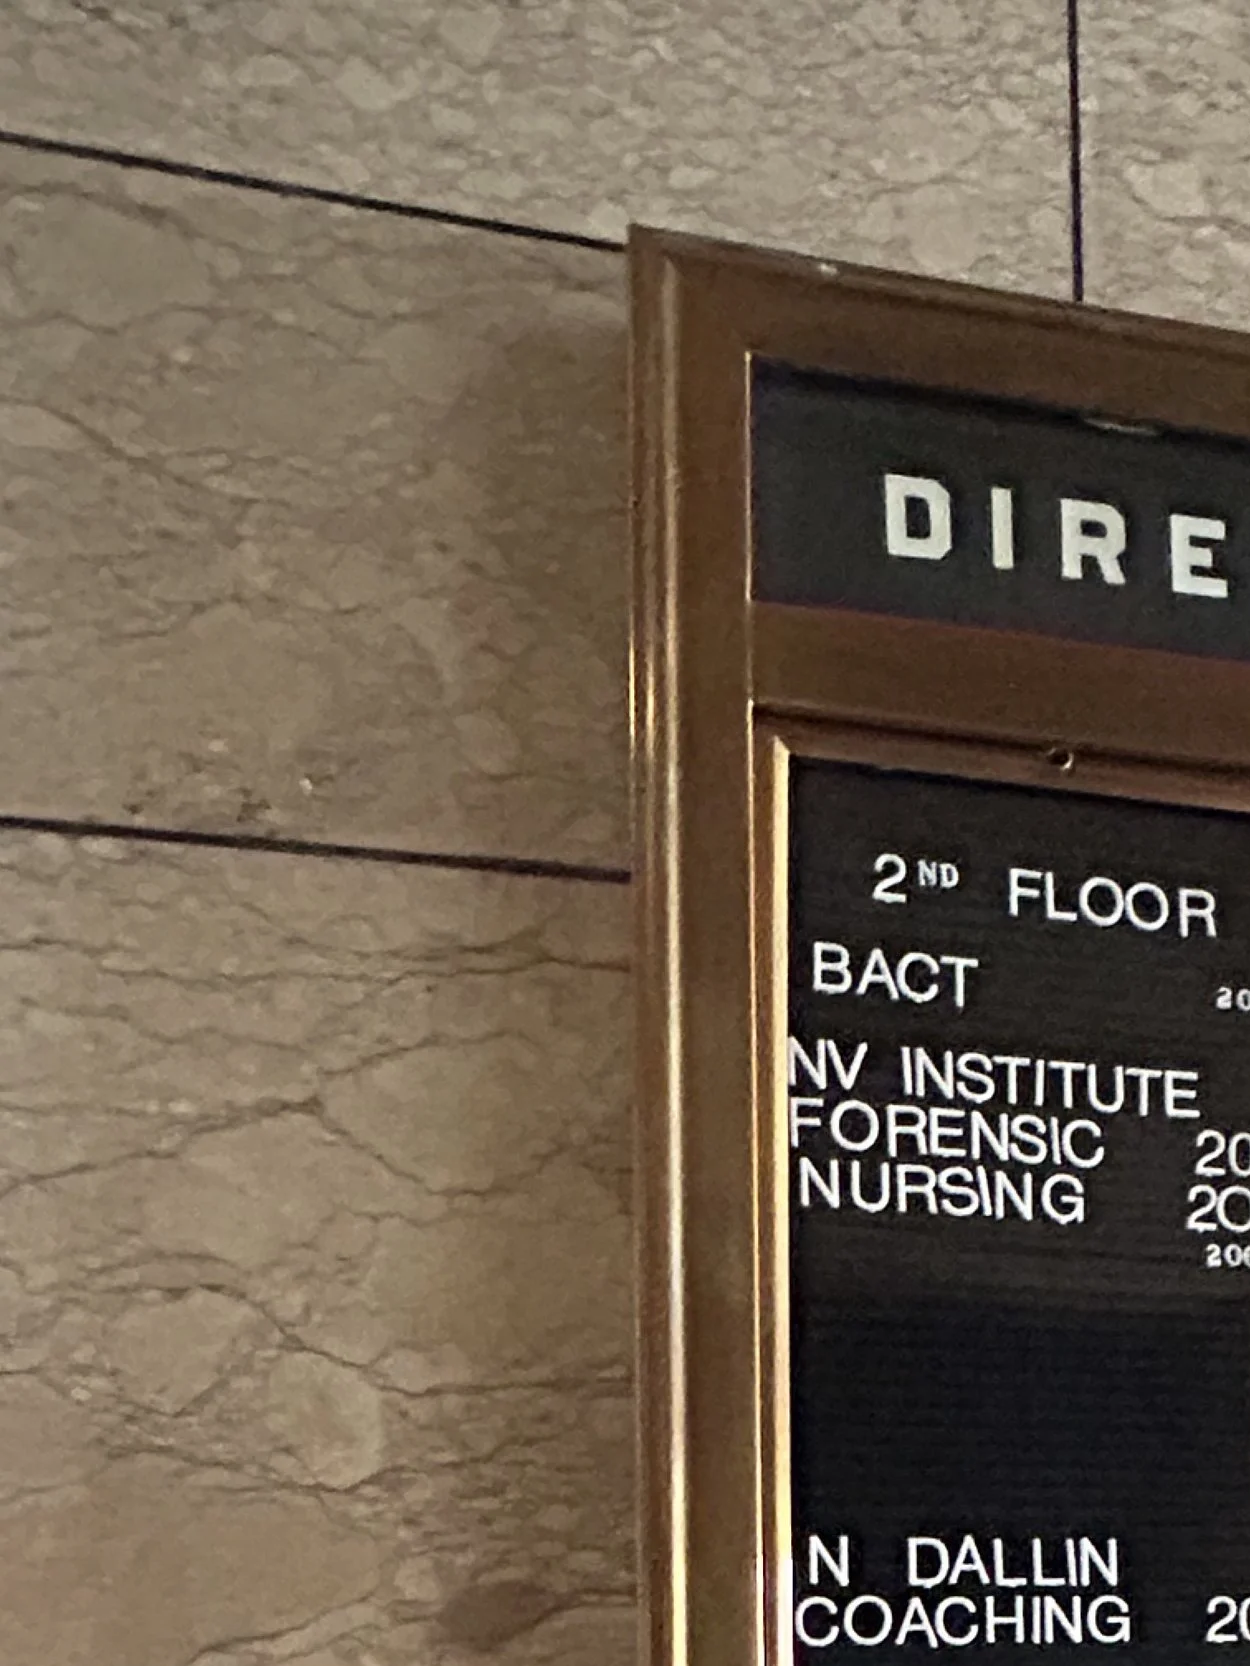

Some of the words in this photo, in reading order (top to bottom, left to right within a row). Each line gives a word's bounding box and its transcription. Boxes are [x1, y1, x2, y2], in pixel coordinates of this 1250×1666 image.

[1008, 867, 1217, 937] FLOOR
[811, 942, 978, 1008] BACT
[787, 1036, 868, 1091] NV
[901, 1046, 1201, 1118] INSTITUTE
[790, 1097, 1105, 1169] FORENSIC
[799, 1156, 1085, 1226] NURSING
[807, 1534, 848, 1587] N
[907, 1535, 1118, 1588] DALLIN
[795, 1595, 1131, 1648] COACHING
